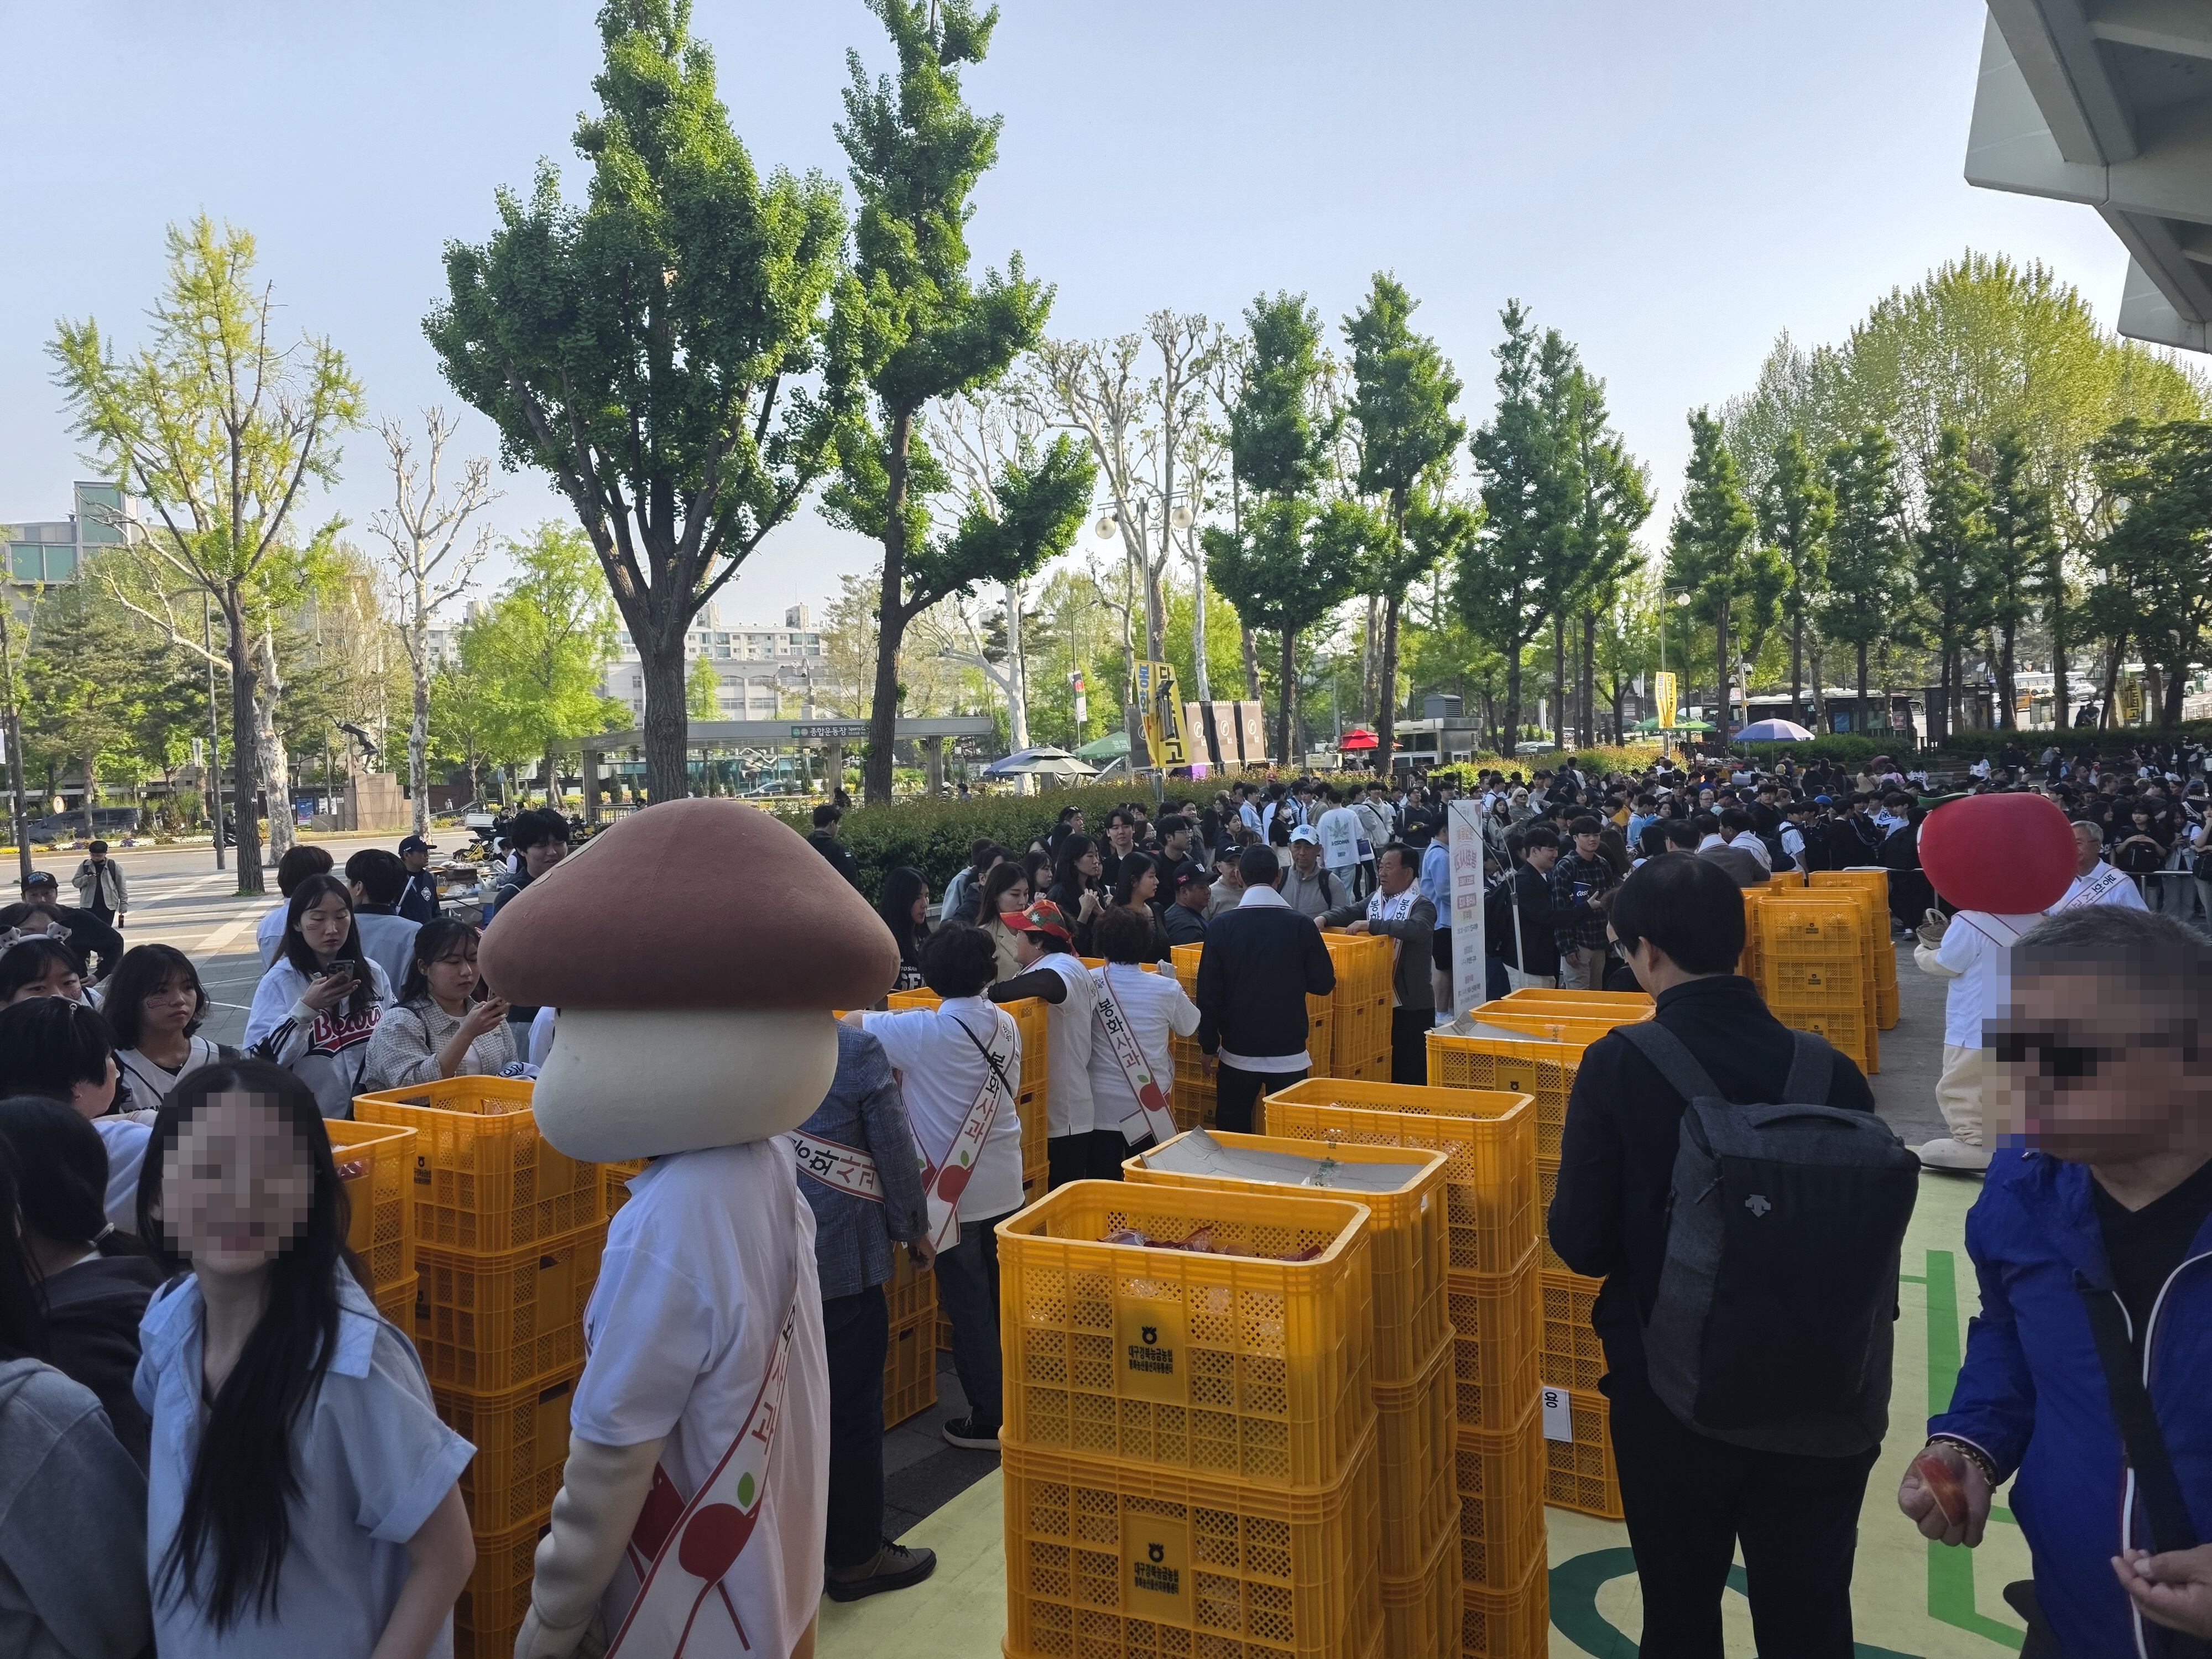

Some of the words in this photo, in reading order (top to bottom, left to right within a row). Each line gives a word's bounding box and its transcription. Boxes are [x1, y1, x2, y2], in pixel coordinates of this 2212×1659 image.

[810, 727, 847, 737] 종합운동장
[314, 1007, 383, 1043] Bears
[1099, 998, 1141, 1068] 봉화사과
[964, 1051, 1006, 1144] 봉화사과
[1129, 1345, 1173, 1363] 대구경북능금농협
[1134, 1562, 1179, 1583] 대구경북능금농협
